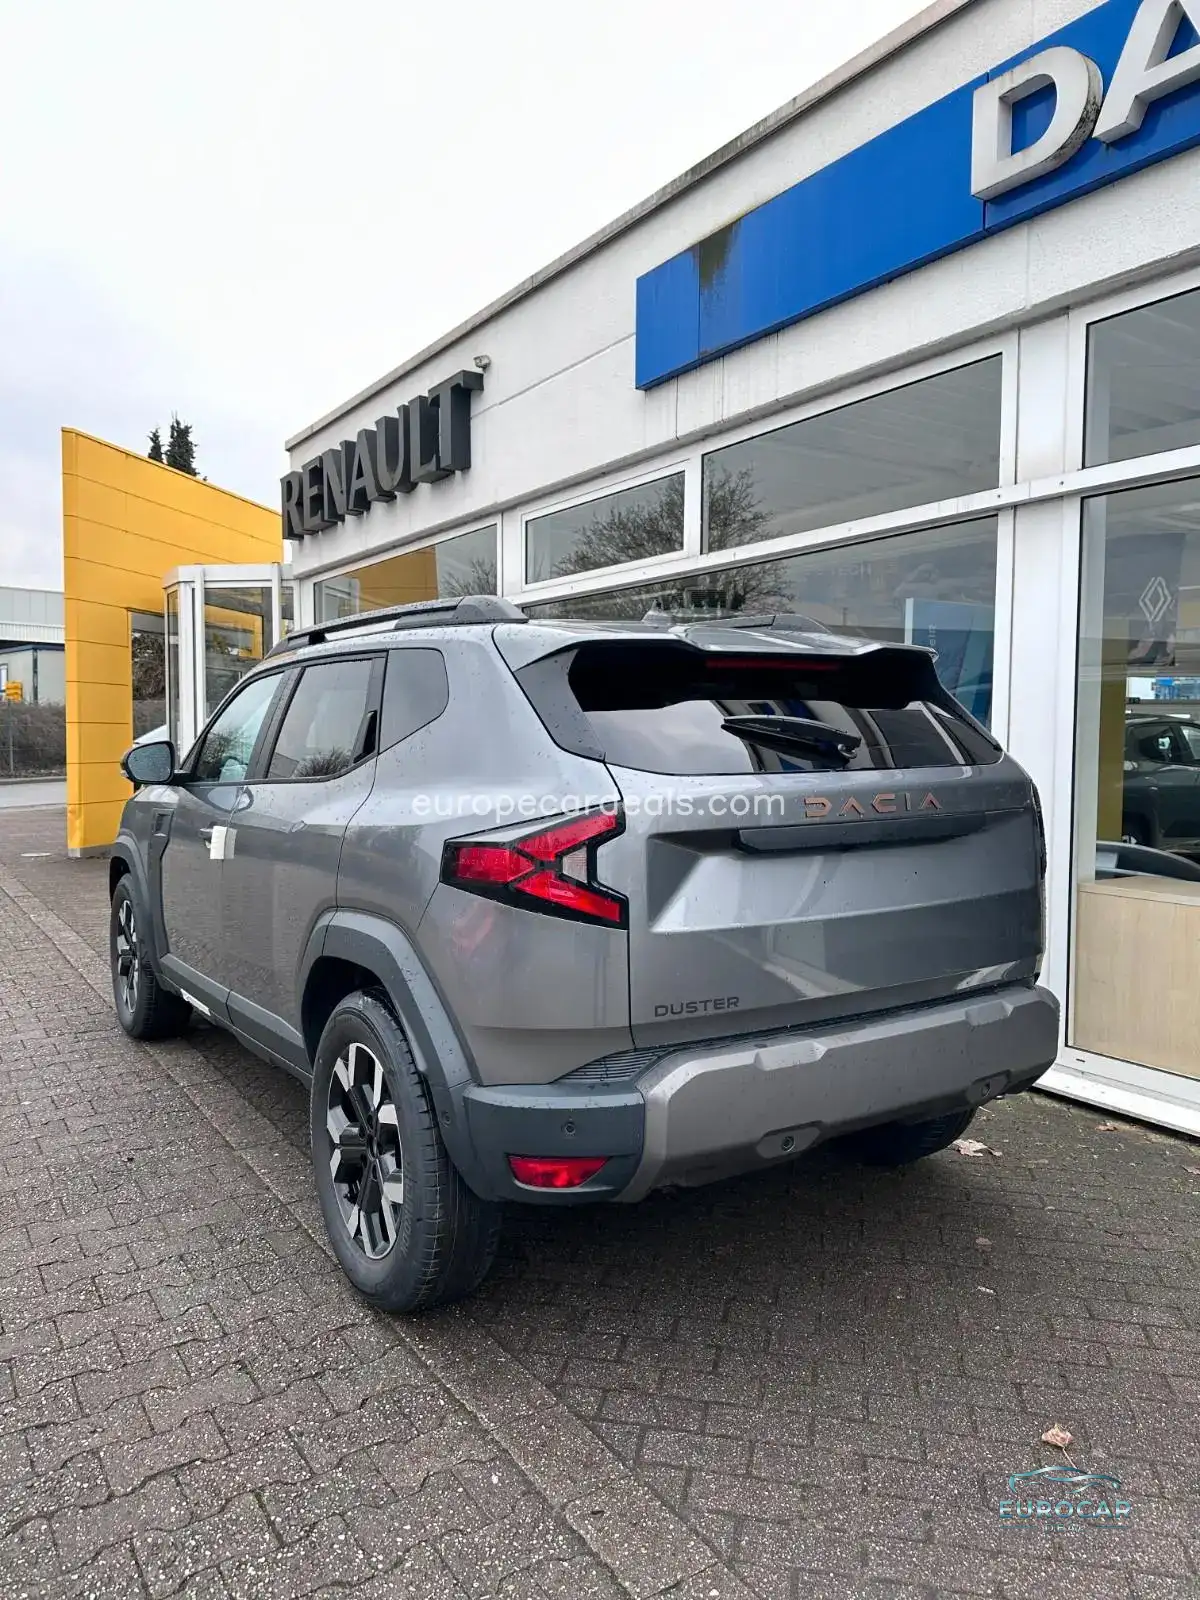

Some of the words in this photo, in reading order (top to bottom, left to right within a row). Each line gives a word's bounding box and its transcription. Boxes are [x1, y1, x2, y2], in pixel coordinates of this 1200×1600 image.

[280, 370, 484, 540] RENAULT
[804, 792, 943, 817] DACIA
[654, 996, 740, 1017] DUSTER
